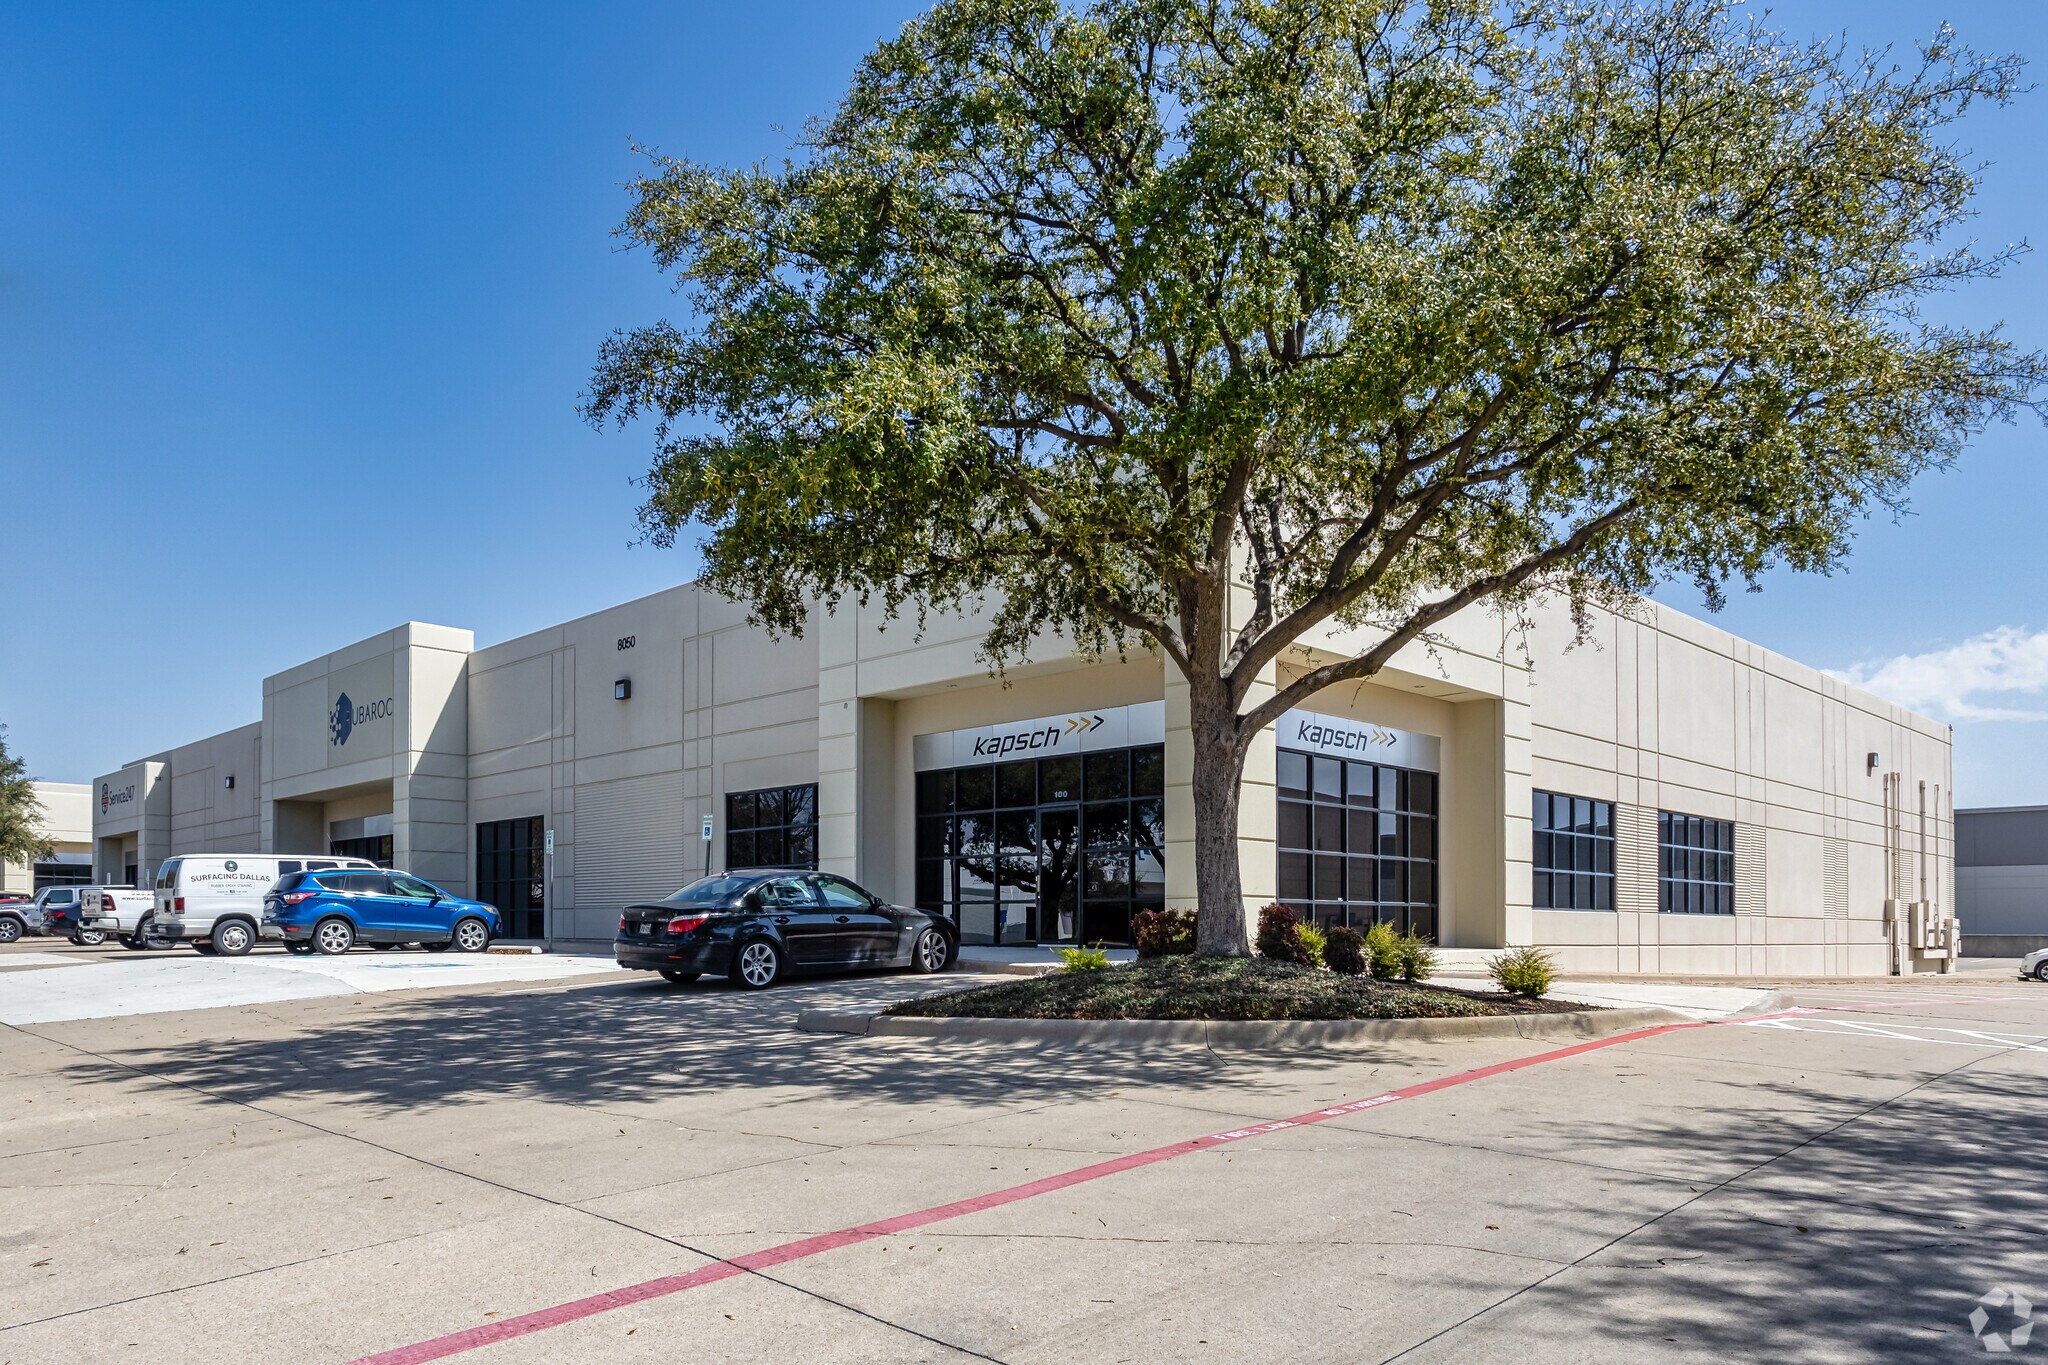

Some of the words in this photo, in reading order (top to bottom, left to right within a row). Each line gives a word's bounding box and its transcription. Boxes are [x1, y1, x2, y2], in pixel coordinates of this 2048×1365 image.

[617, 635, 636, 651] 8050
[973, 726, 1061, 757] kapsch
[1297, 720, 1368, 751] kapsch
[1054, 790, 1068, 798] 100
[190, 873, 238, 882] SURFACING
[239, 873, 271, 882] DALLAS
[1211, 1129, 1259, 1140] FIRE
